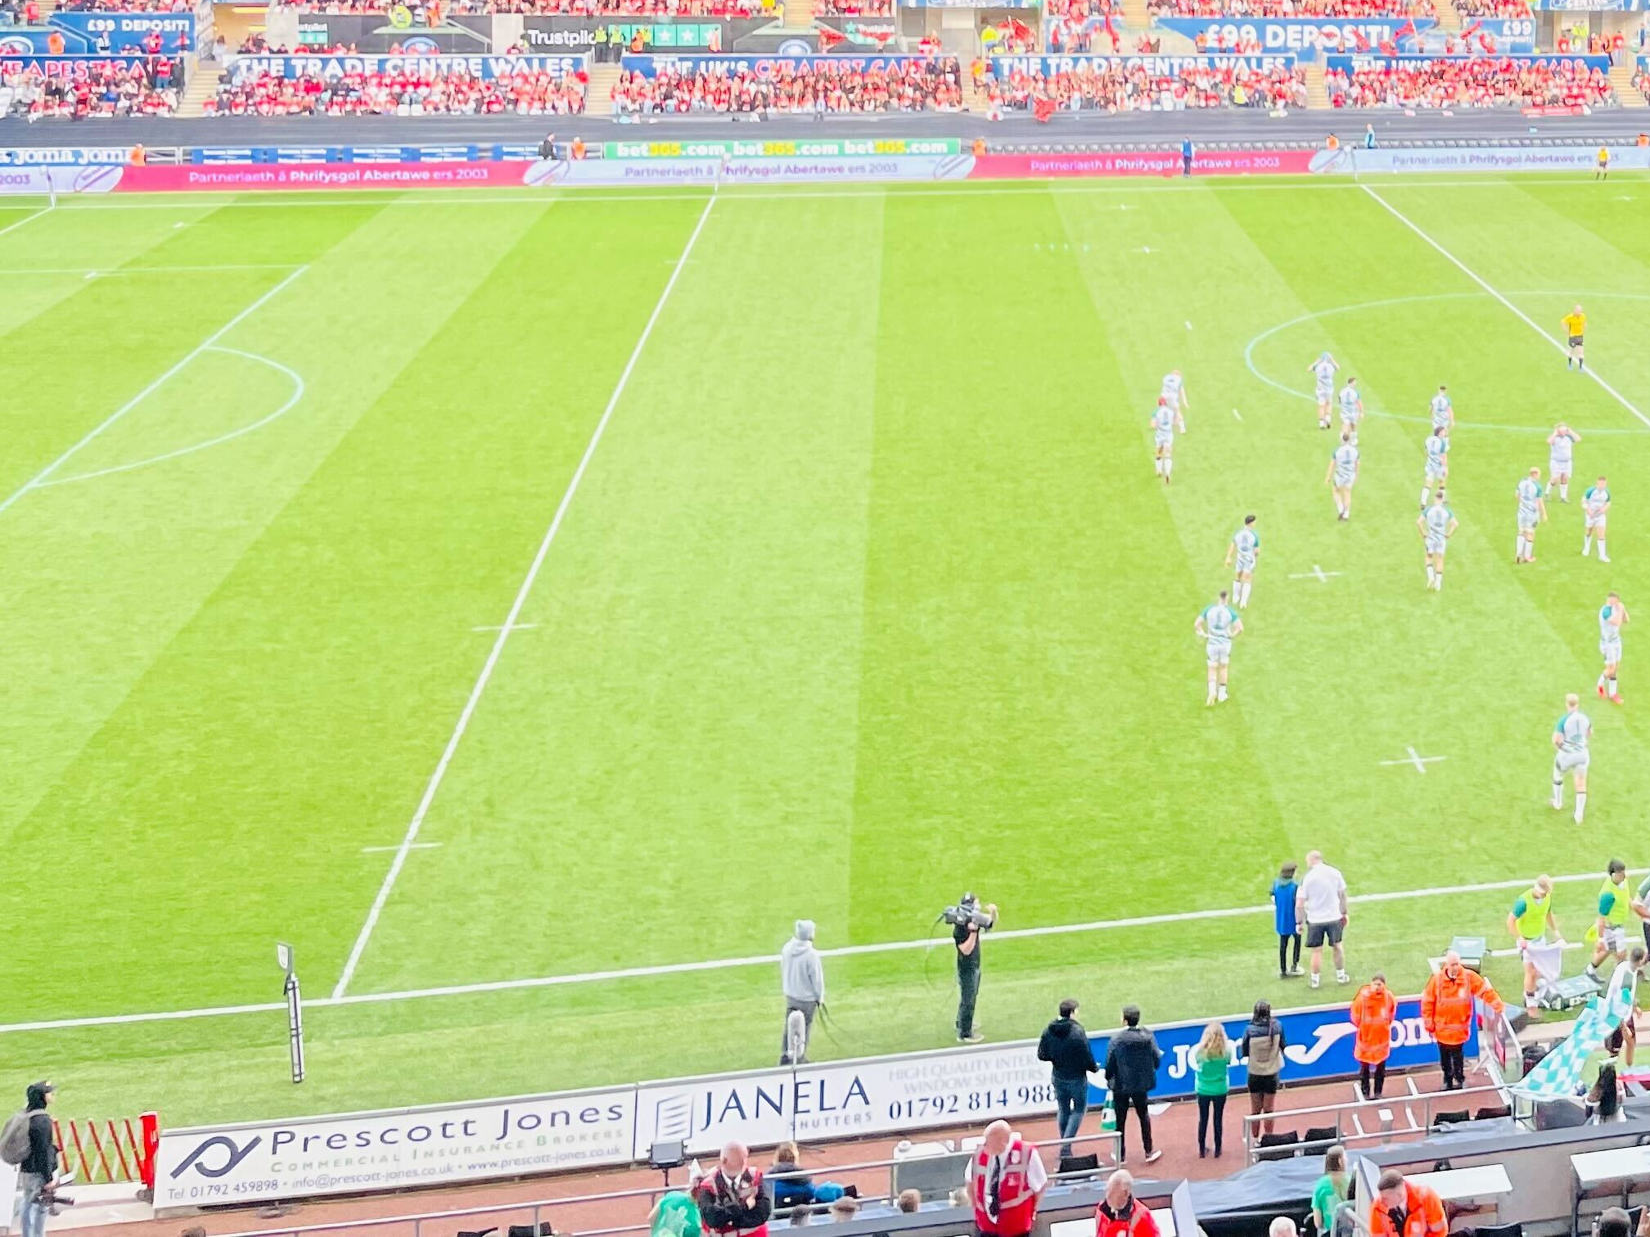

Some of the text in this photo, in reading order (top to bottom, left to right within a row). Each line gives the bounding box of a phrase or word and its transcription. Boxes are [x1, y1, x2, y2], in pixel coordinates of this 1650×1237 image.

[1206, 23, 1390, 49] £99 DEPOSIT!
[1502, 20, 1532, 36] £99
[238, 57, 574, 78] THE TRADE CENTRE WALES
[999, 58, 1041, 75] THE
[617, 139, 948, 157] bet365.com bet365.com bet365.com
[1176, 158, 1232, 169] Aertawe
[189, 171, 273, 183] Partneriaeth
[290, 169, 360, 184] Phrifysgol
[363, 169, 430, 181] Abertawe
[456, 168, 488, 180] 2003
[930, 1057, 990, 1079] QUALITY
[903, 1066, 1045, 1094] WINDOW SHUTTERS
[700, 1075, 870, 1131] JANELA
[889, 1083, 1058, 1120] 01792 814 988
[271, 1104, 624, 1155] Prescott Jones
[190, 1183, 229, 1198] 01792
[233, 1179, 279, 1193] 459898
